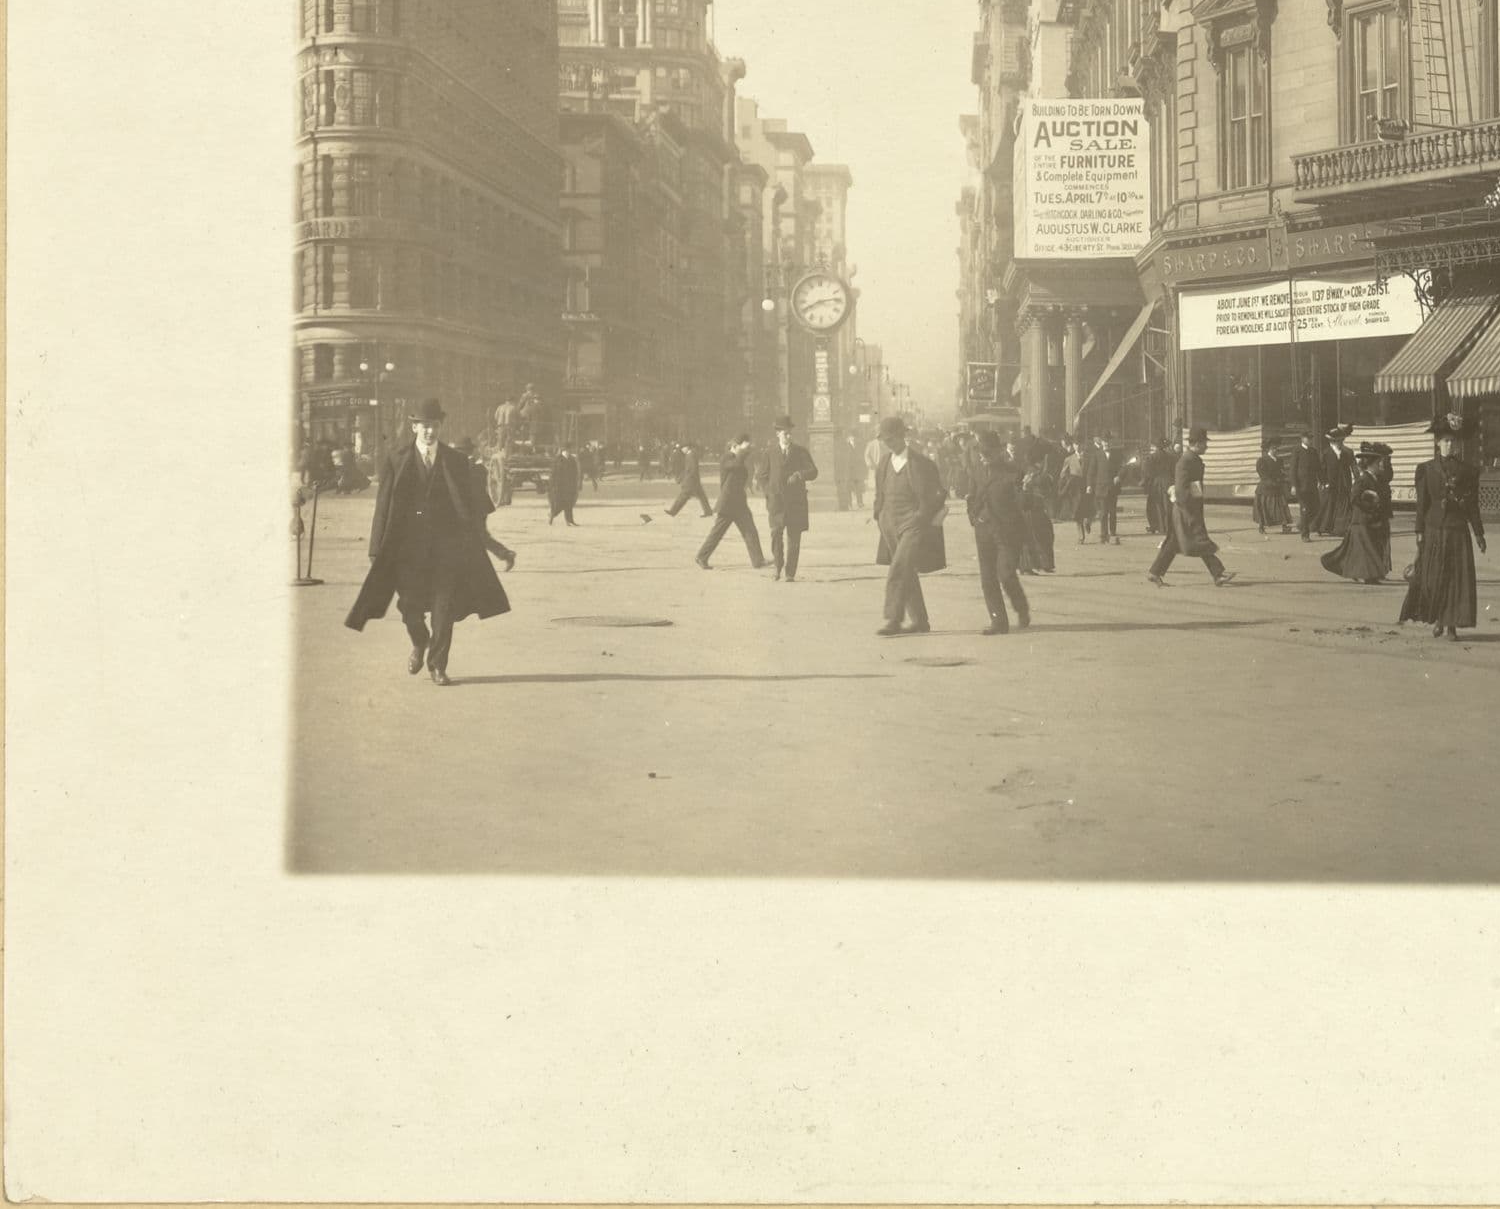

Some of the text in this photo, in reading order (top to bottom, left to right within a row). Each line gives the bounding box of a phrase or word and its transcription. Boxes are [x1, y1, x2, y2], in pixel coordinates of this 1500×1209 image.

[1032, 103, 1066, 117] BUILDING
[1067, 104, 1077, 116] TO
[1079, 104, 1089, 116] BE
[1091, 104, 1111, 116] TORN
[1034, 120, 1138, 148] AUCTION
[1069, 139, 1137, 151] SALE.
[1060, 154, 1135, 169] FURNITURE
[1036, 170, 1138, 184] & Complete Equipment
[1036, 223, 1089, 235] AUGUSTUS
[1163, 252, 1217, 275] SHARP
[1217, 297, 1236, 310] ABOUT
[1237, 296, 1251, 308] JUNE
[1362, 299, 1380, 310] GRADE
[1216, 325, 1239, 335] FOREIGN
[1297, 319, 1308, 329] 25
